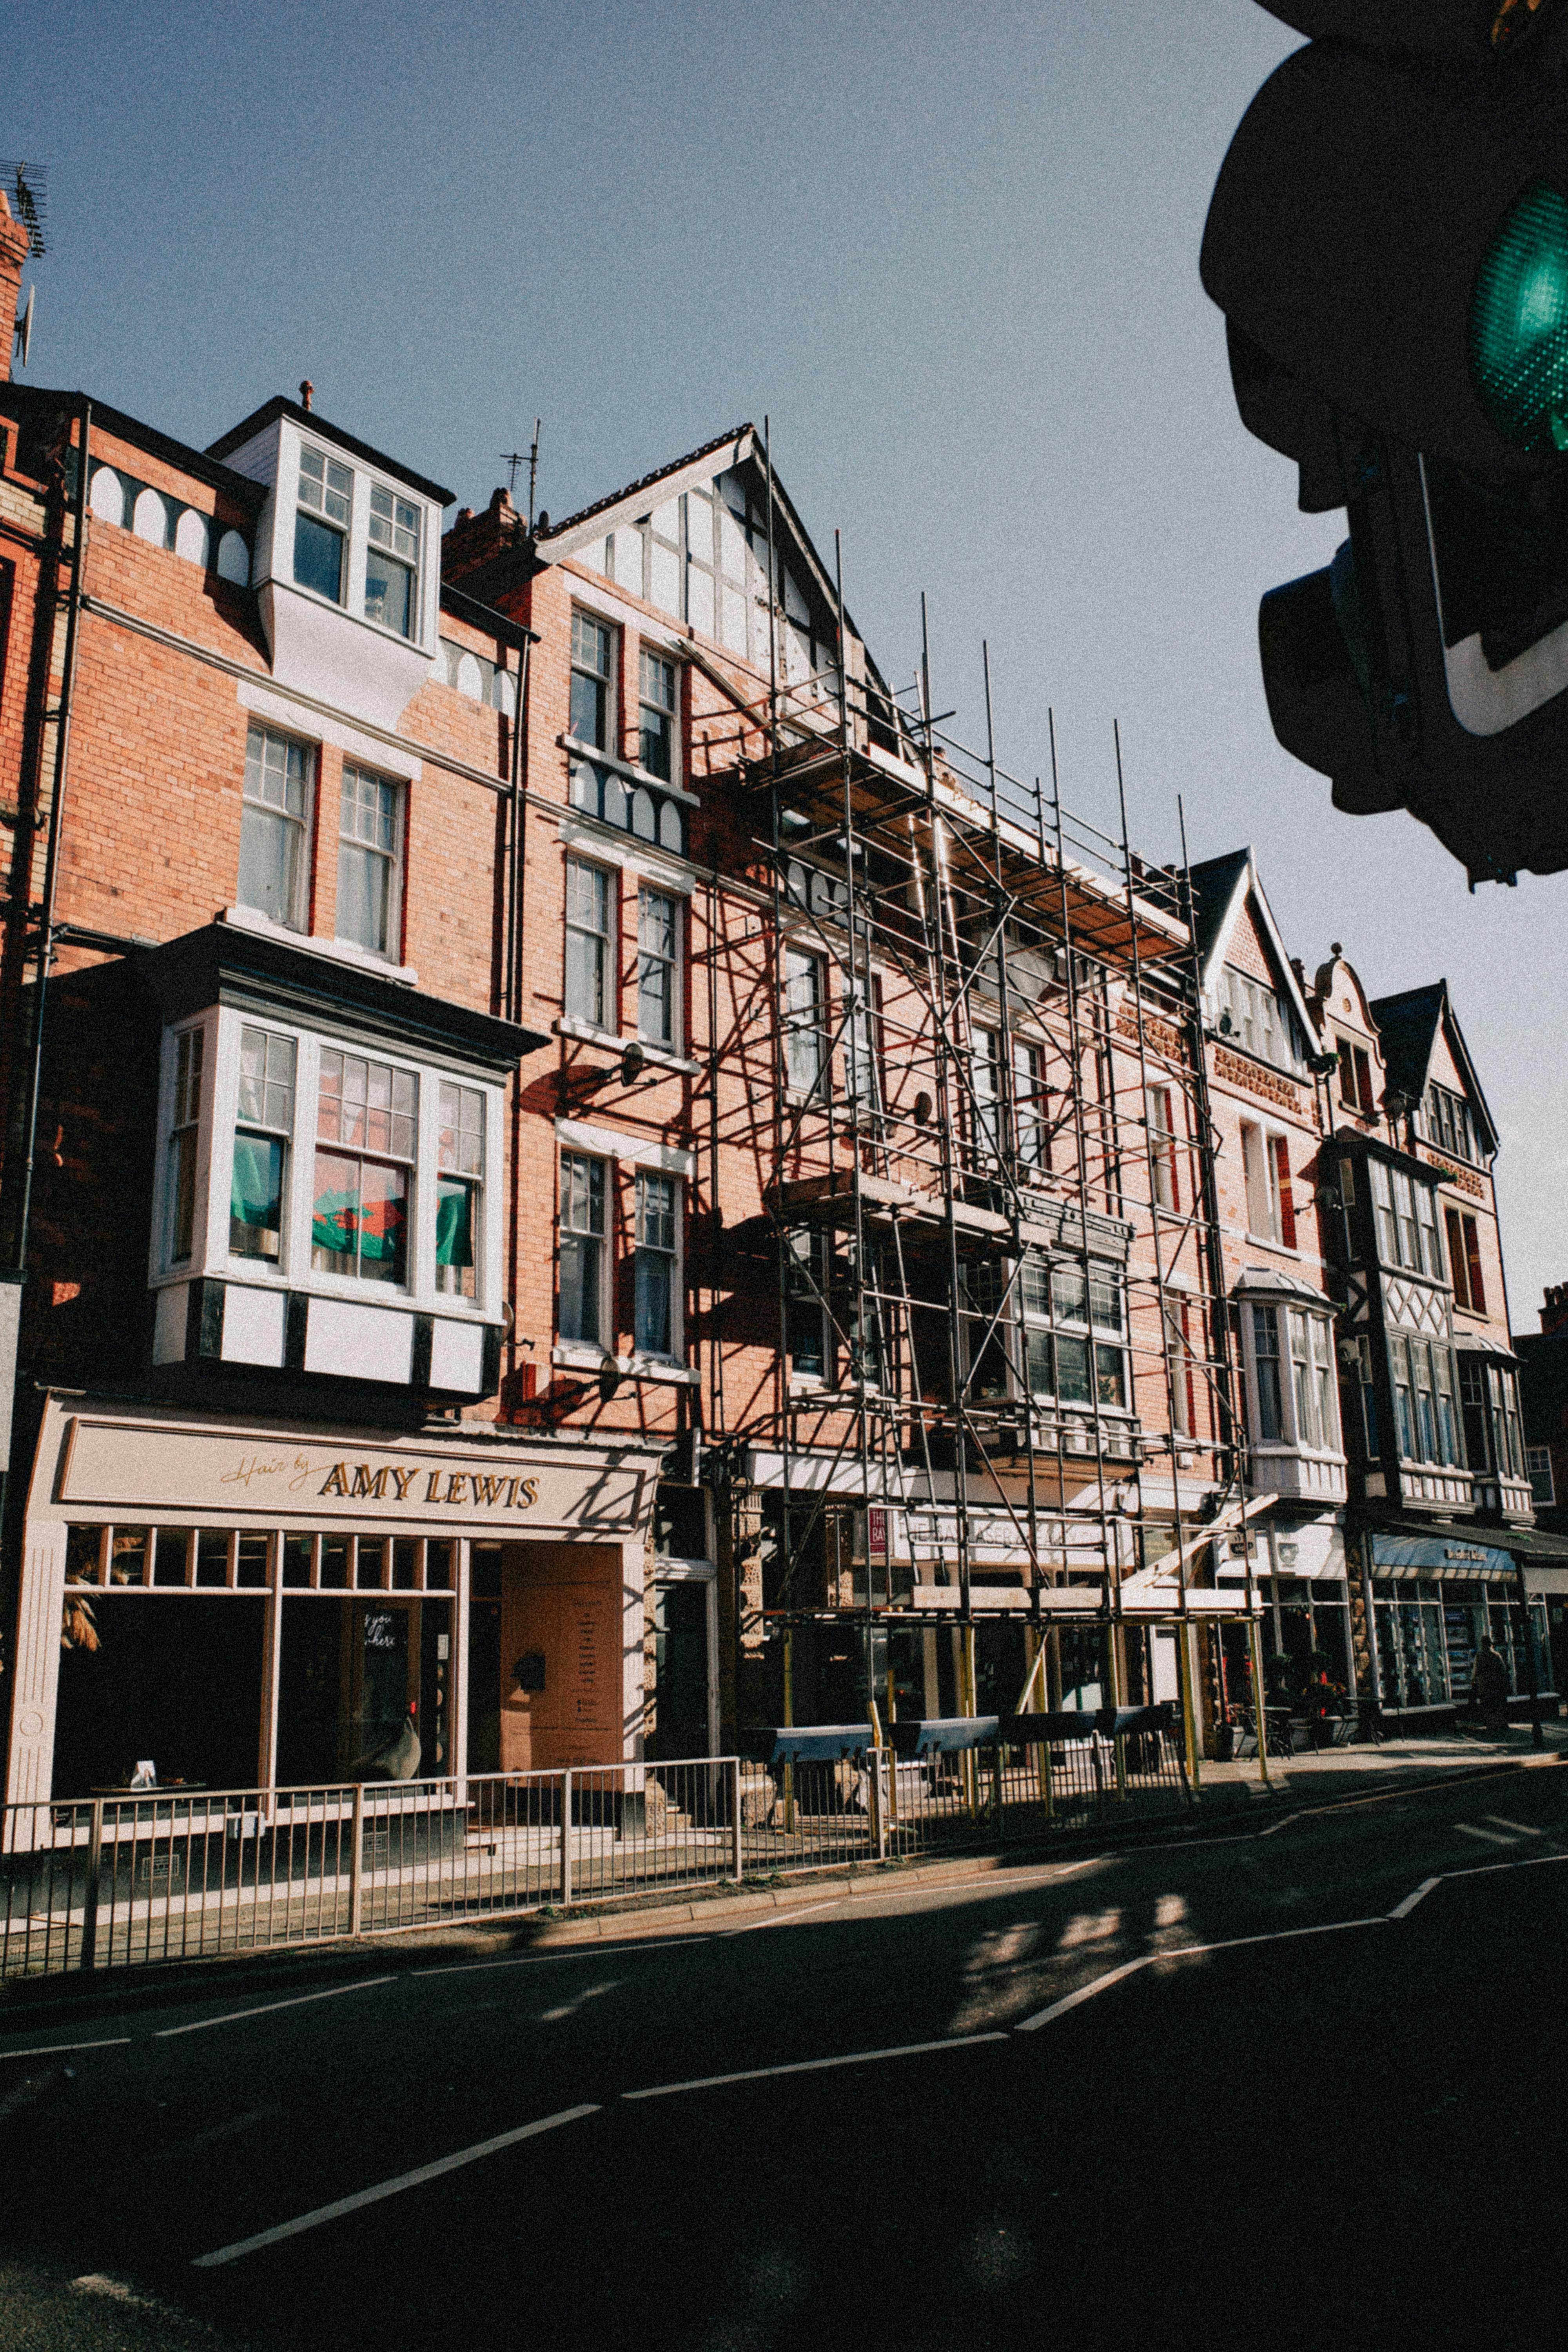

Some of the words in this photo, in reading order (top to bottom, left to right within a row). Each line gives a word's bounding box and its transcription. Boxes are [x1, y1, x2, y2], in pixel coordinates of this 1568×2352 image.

[220, 1456, 287, 1487] Hair
[317, 1461, 422, 1501] AMY
[423, 1470, 540, 1509] LEWIS
